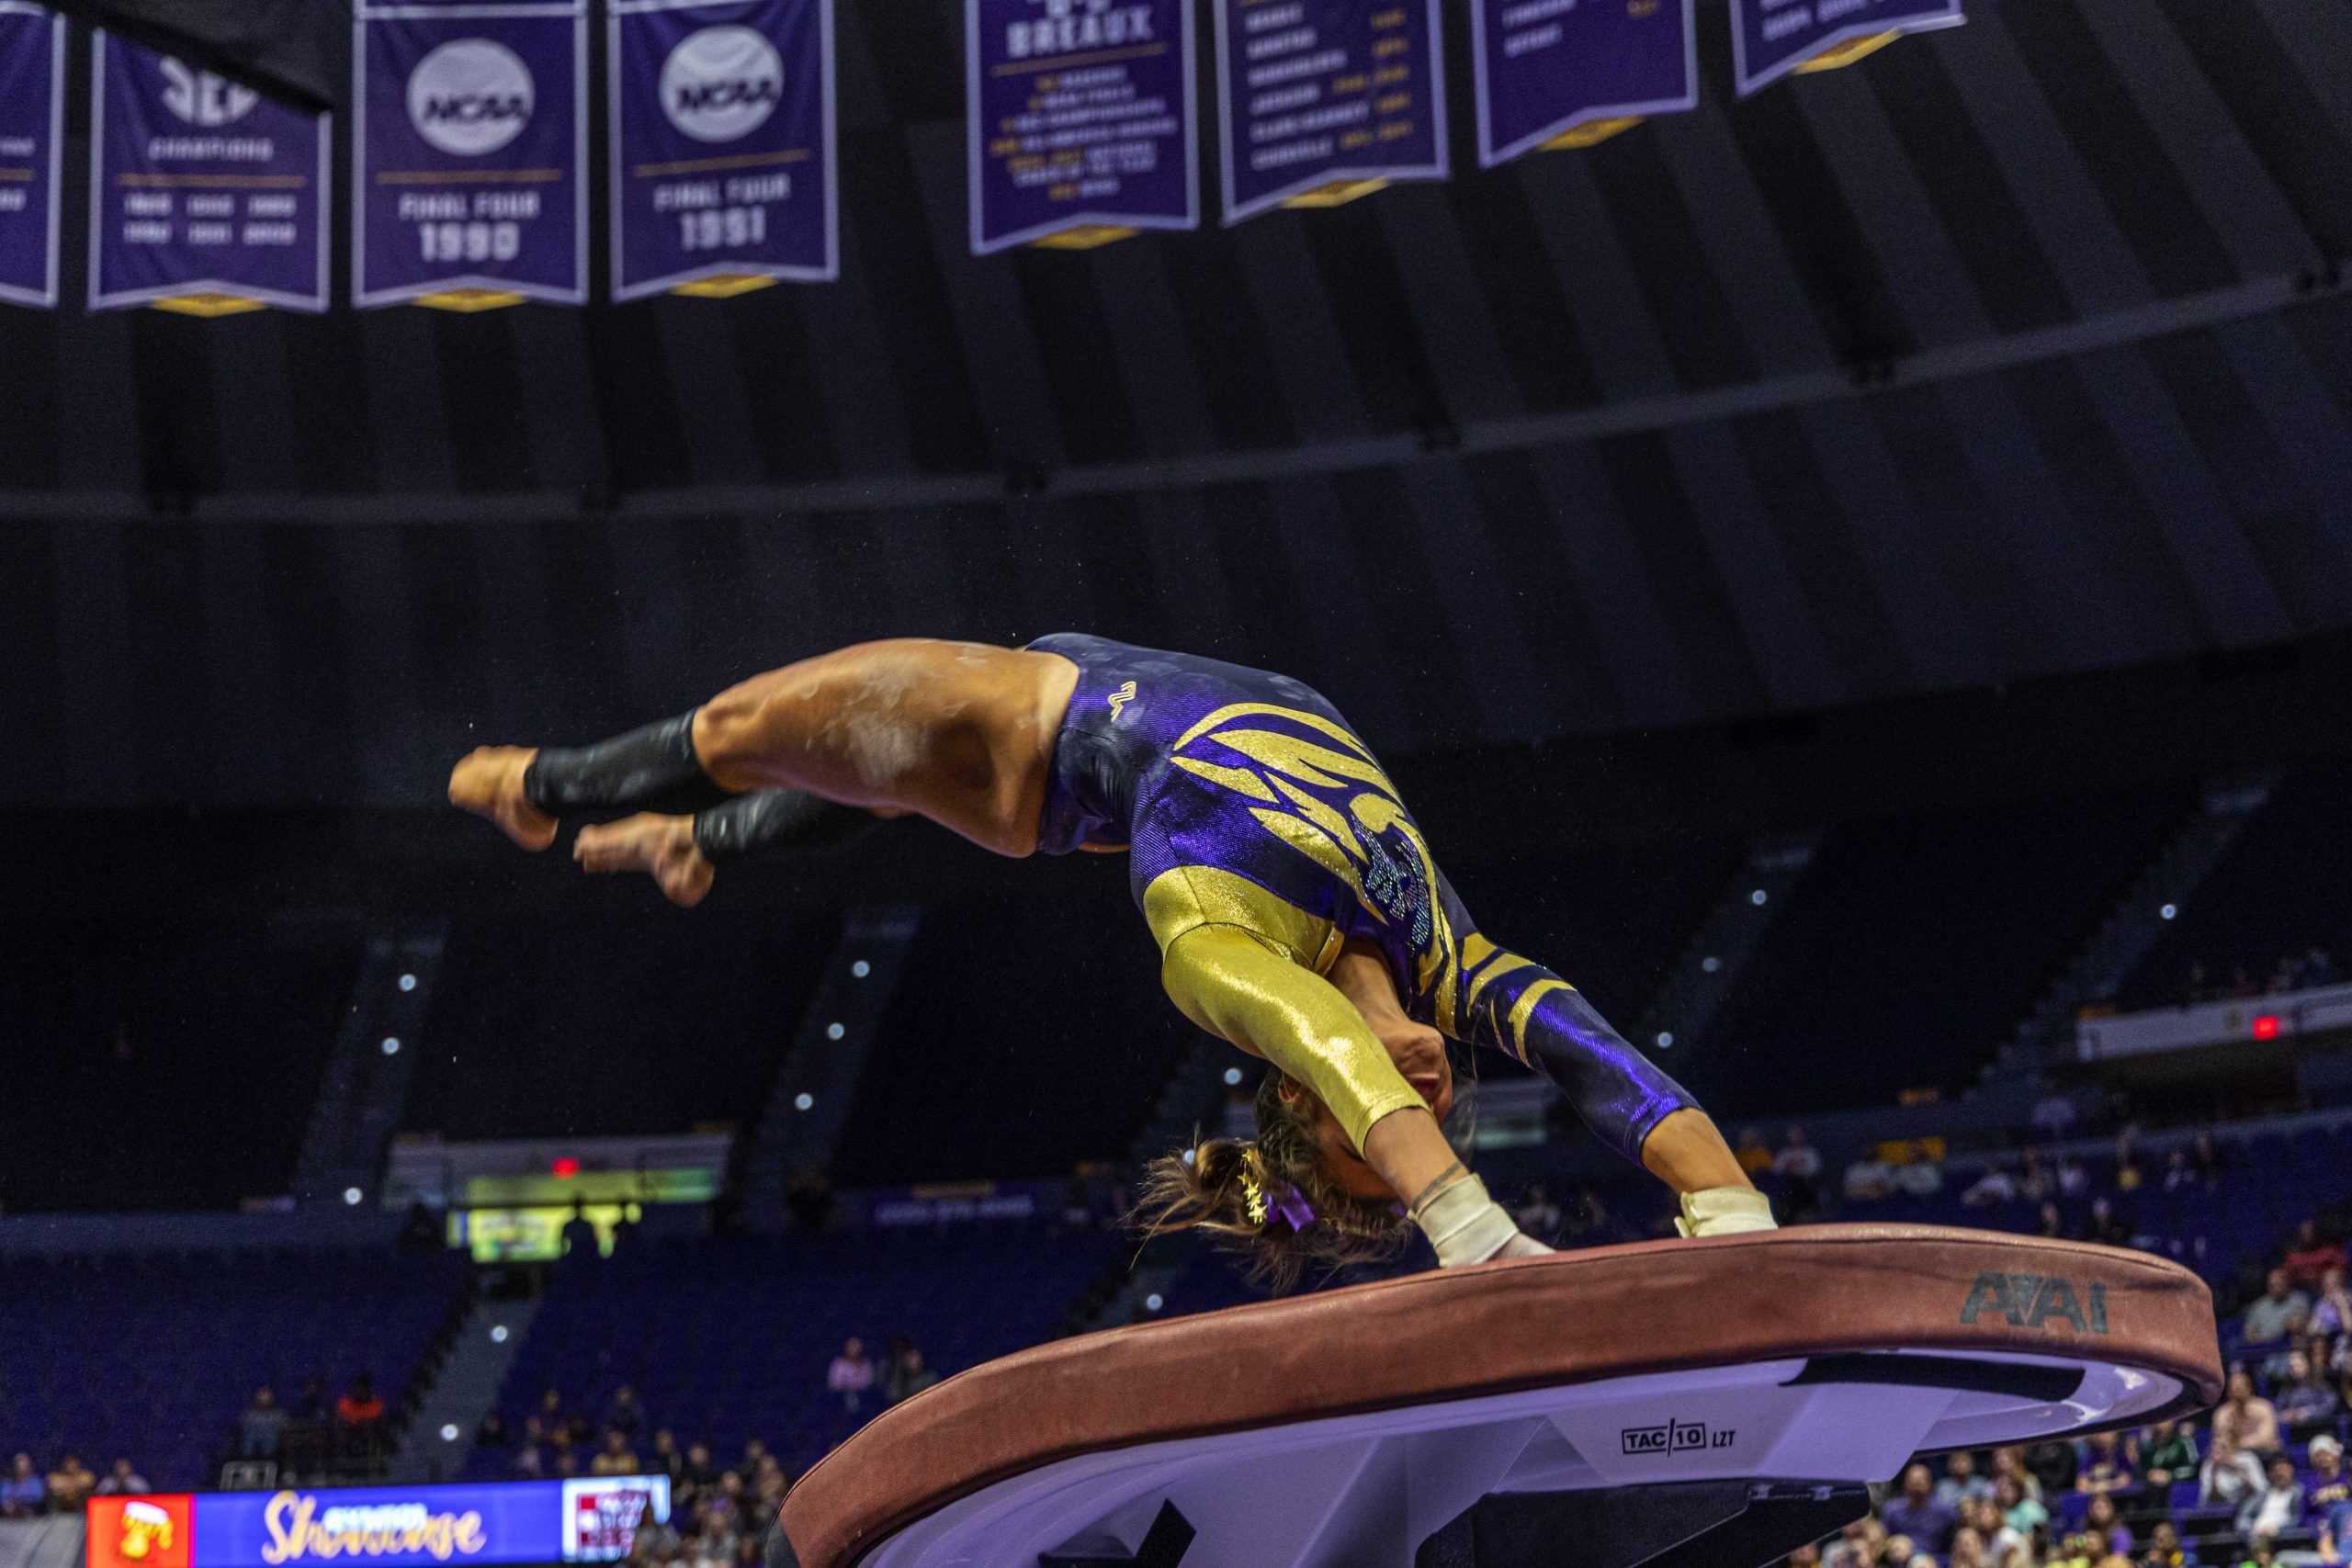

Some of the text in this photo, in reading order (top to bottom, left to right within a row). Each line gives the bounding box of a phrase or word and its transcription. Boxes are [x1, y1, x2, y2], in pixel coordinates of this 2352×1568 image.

[1006, 5, 1154, 57] BREAUX
[424, 94, 528, 123] NCAA
[678, 80, 778, 111] NCAA
[398, 190, 542, 220] FINAL FOUR
[653, 174, 793, 212] FINAL FOUR
[419, 221, 520, 263] 1990
[680, 204, 766, 252] 1991
[1711, 1430, 1736, 1449] LZT
